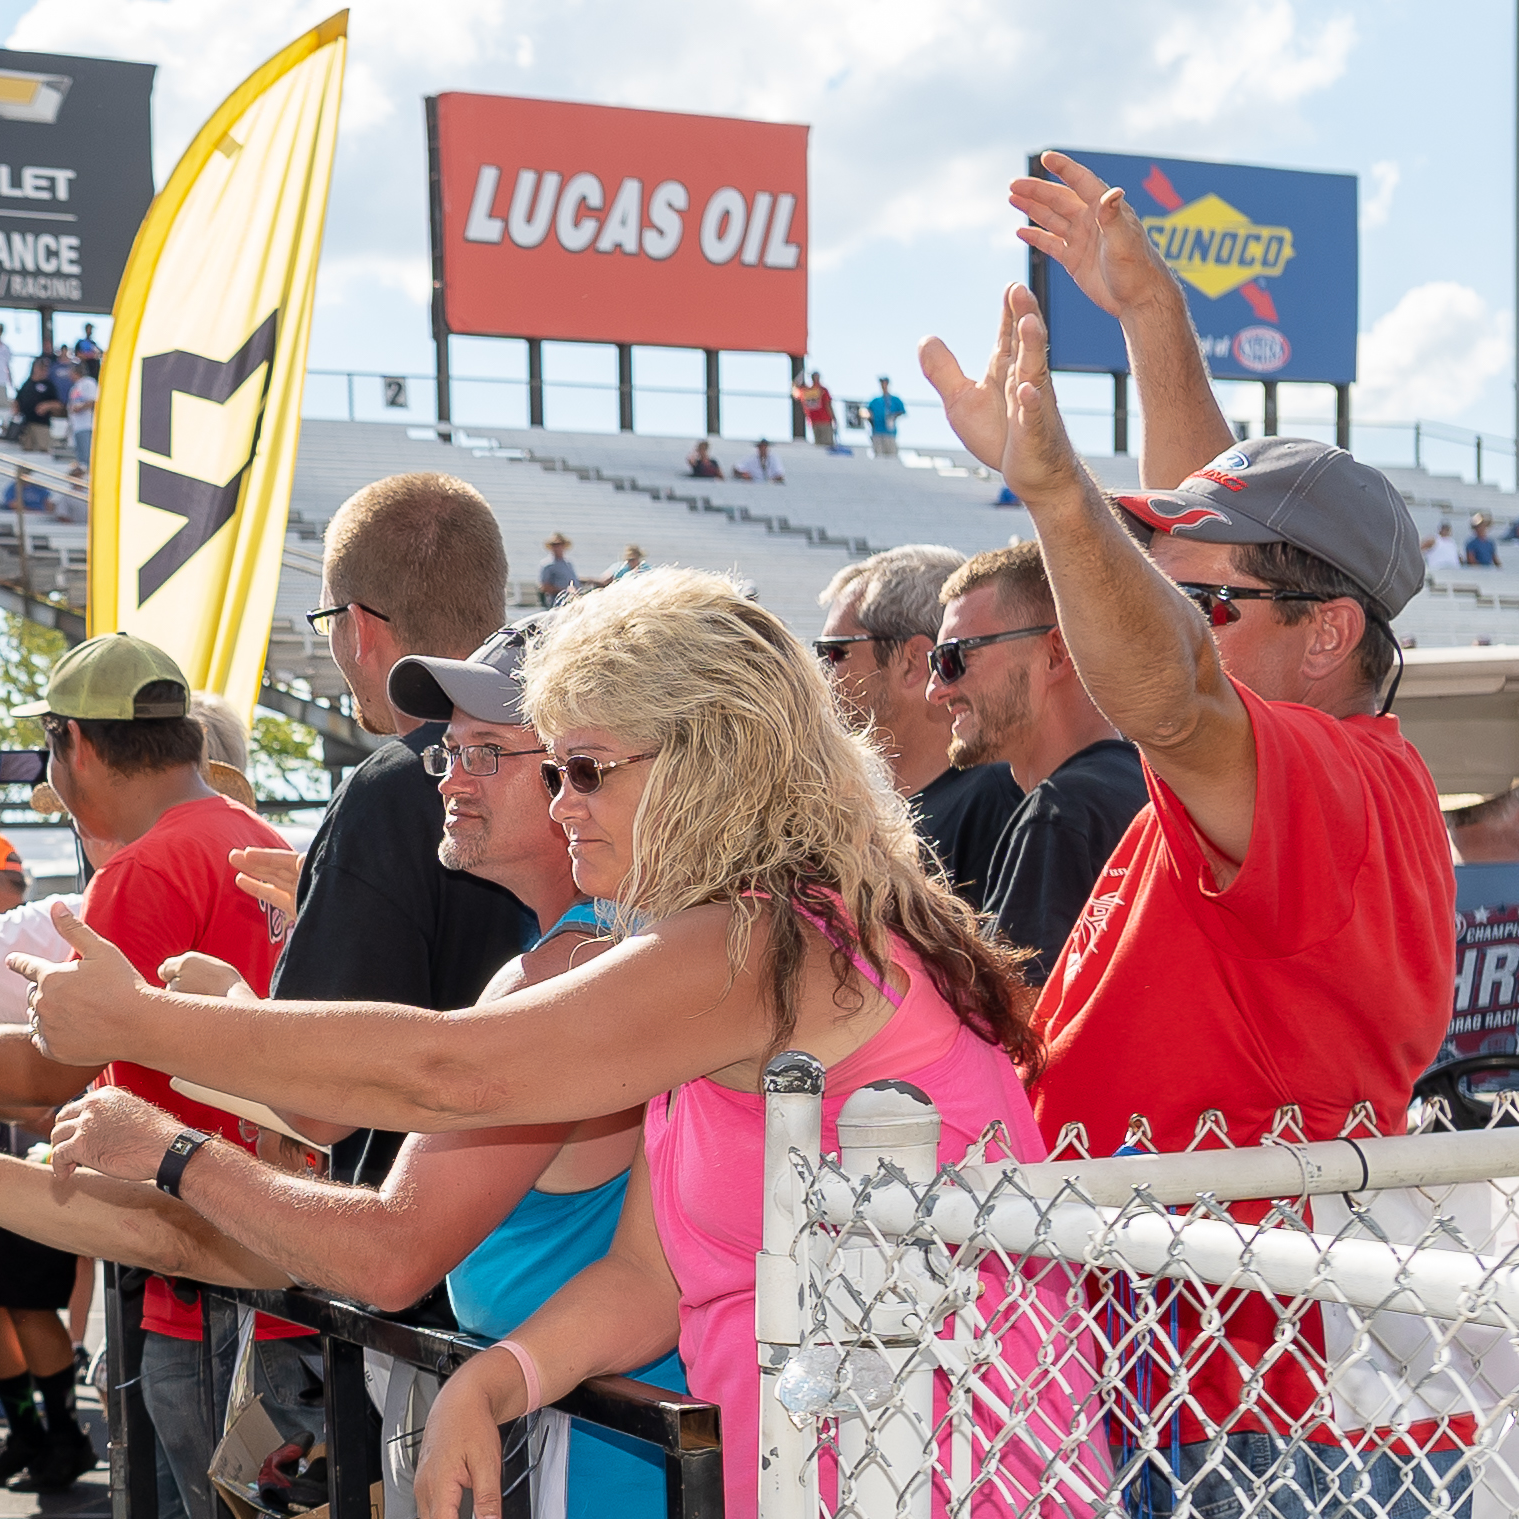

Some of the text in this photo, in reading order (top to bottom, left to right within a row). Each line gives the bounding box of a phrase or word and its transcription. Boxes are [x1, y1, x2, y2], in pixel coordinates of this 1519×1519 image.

[464, 164, 801, 269] LUCAS OIL
[1146, 224, 1285, 268] SUNOCO
[10, 273, 82, 301] RACING
